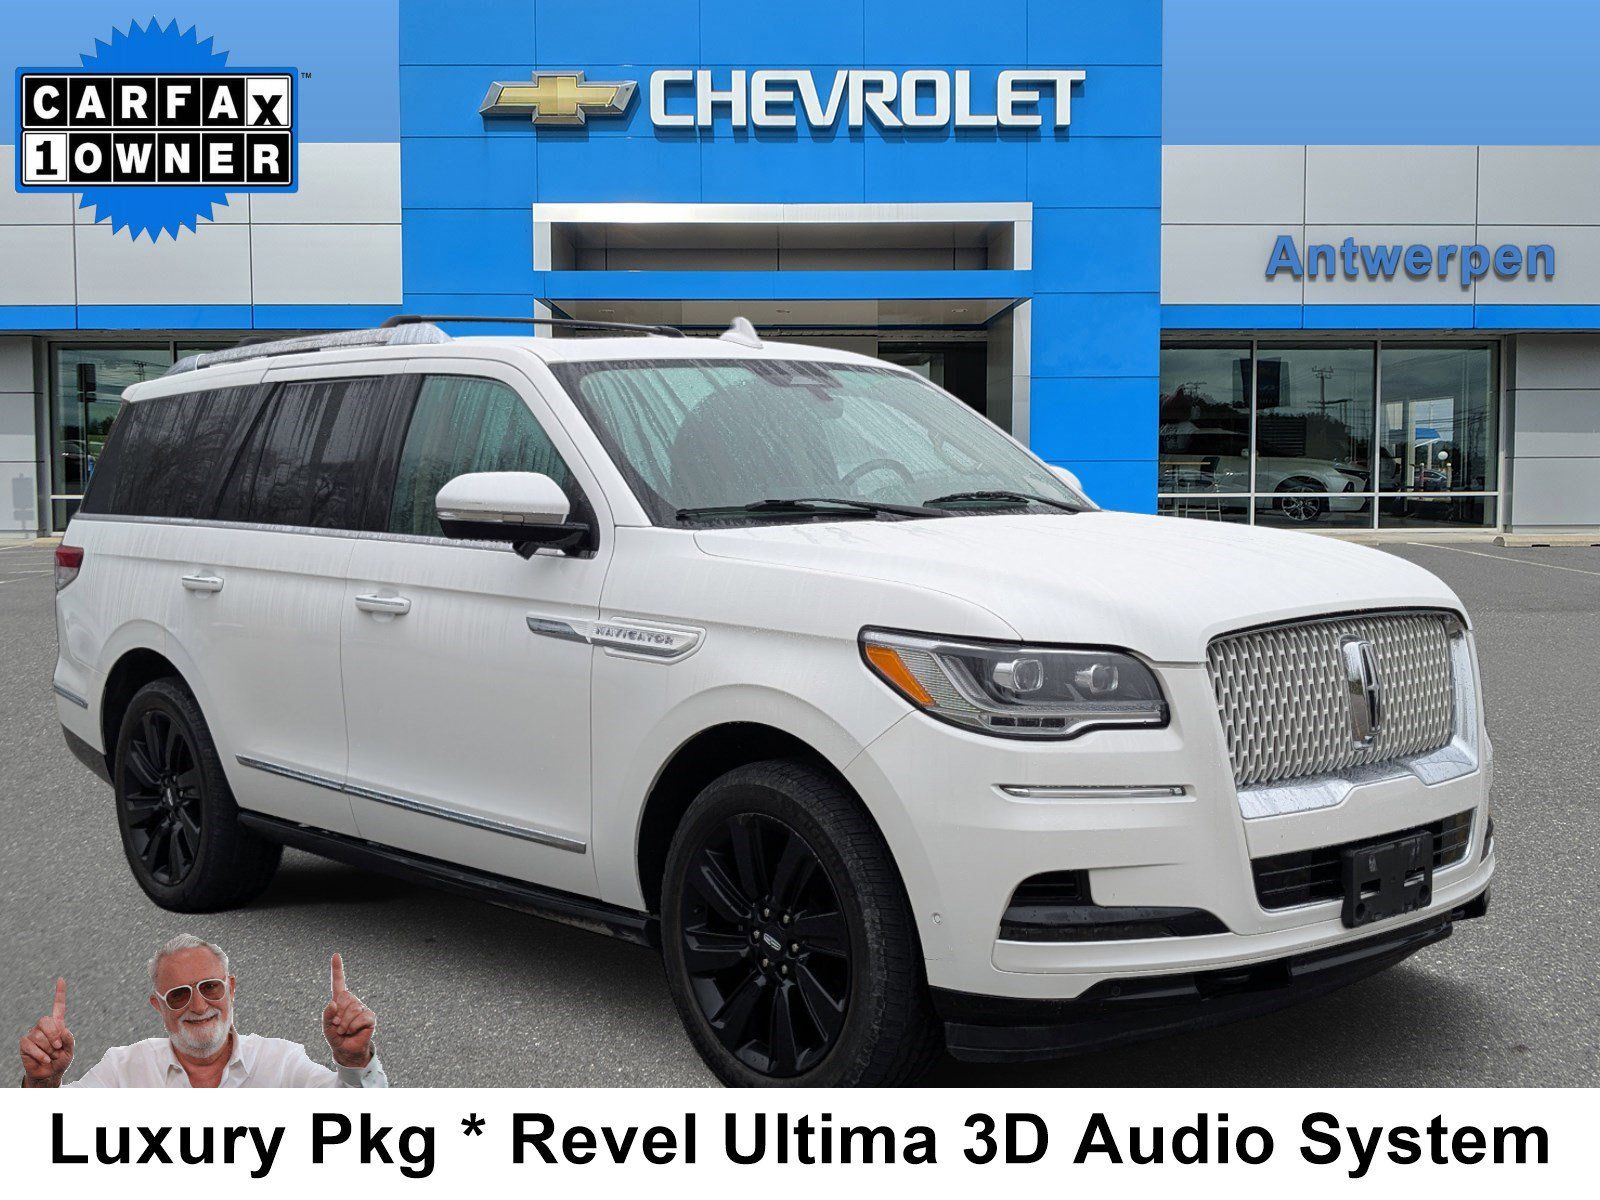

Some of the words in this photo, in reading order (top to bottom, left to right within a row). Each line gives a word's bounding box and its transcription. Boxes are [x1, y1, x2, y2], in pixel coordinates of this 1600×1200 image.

[650, 69, 1086, 128] CHEVROLET
[1265, 235, 1556, 287] Antwerpen
[594, 625, 674, 645] NAVIGATOR
